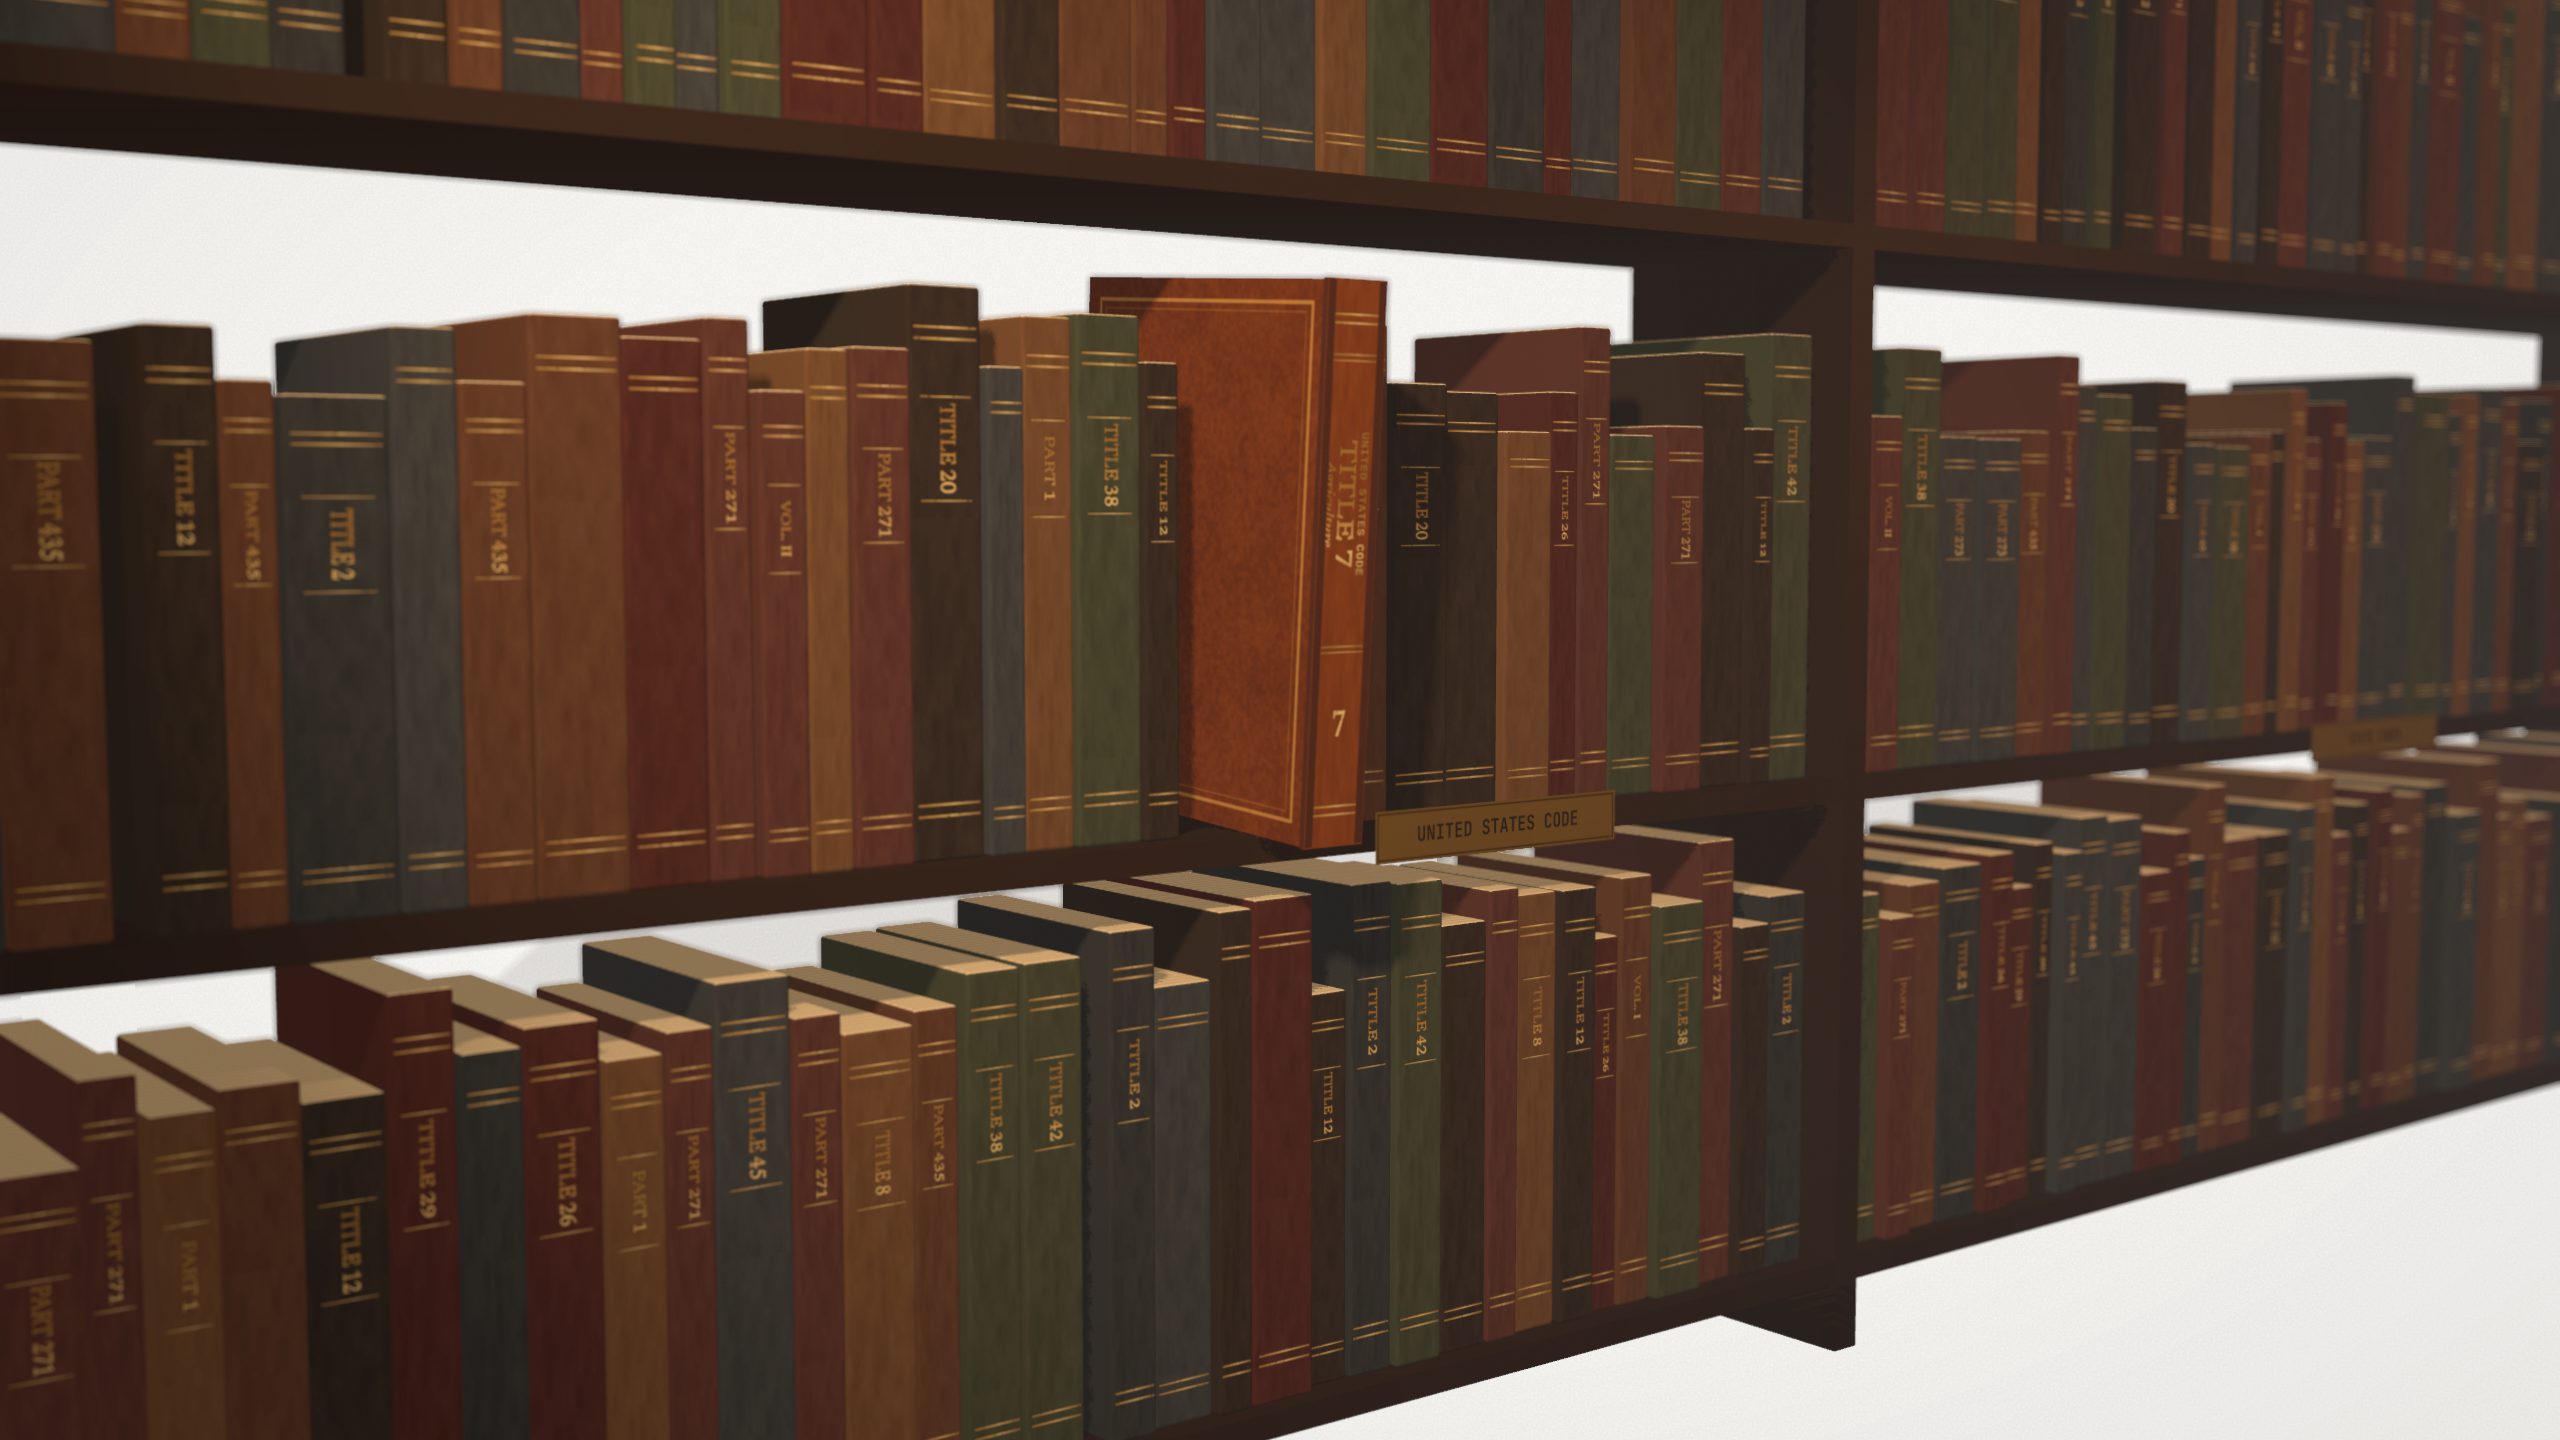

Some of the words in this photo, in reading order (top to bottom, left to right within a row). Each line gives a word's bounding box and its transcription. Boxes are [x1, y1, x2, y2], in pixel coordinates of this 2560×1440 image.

[939, 402, 958, 466] TITLE
[1104, 423, 1119, 481] TITLE
[1787, 425, 1799, 475] TITLE
[724, 431, 738, 484] PART
[1044, 436, 1056, 486] PART
[1360, 432, 1370, 481] UNITED
[1916, 433, 1928, 480] TITLE
[36, 460, 63, 521] PART
[174, 447, 196, 517] TITLE
[878, 453, 892, 502] PART
[939, 470, 958, 495] 20
[1159, 460, 1168, 513] TITLE
[1335, 440, 1358, 541] TITLE
[1416, 472, 1429, 519] TITLE
[1592, 470, 1600, 500] 271
[1786, 476, 1798, 497] 42
[489, 487, 508, 538] PART
[724, 489, 738, 523] 271
[1044, 492, 1056, 501] 1
[1104, 485, 1119, 508] 38
[1357, 488, 1368, 536] STATES
[1561, 475, 1569, 520] TITLE
[176, 522, 197, 548] 12
[243, 490, 261, 544] PART
[878, 506, 893, 538] 271
[1159, 516, 1168, 536] 12
[1416, 521, 1429, 541] 20
[1560, 523, 1569, 541] 26
[1681, 499, 1692, 534] PART
[328, 506, 356, 566] TITLE
[780, 545, 793, 558] II
[1680, 536, 1692, 560] 271
[330, 567, 357, 582] 2
[490, 538, 509, 575] 435
[1335, 550, 1353, 569] 7
[1355, 543, 1365, 576] CODE
[1332, 709, 1346, 738] 7
[1416, 820, 1473, 842] UNITED
[1481, 814, 1536, 836] STATES
[1544, 809, 1579, 829] CODE
[1713, 929, 1723, 971] PART
[1416, 979, 1428, 1032] TITLE
[1576, 976, 1585, 1024] TITLE
[1678, 983, 1690, 1026] TITLE
[1712, 974, 1723, 1003] 271
[1782, 972, 1793, 1014] TITLE
[1368, 987, 1378, 1041] TITLE
[1532, 986, 1543, 1034] TITLE
[1782, 1015, 1792, 1025] 2
[1368, 1044, 1378, 1056] 2
[1416, 1035, 1428, 1056] 42
[1532, 1037, 1542, 1047] 8
[1576, 1028, 1584, 1046] 12
[1602, 1012, 1610, 1054] TITLE
[1677, 1028, 1689, 1046] 38
[1128, 1037, 1142, 1095] TITLE
[1602, 1055, 1610, 1073] 26
[990, 1072, 1003, 1128] TITLE
[1050, 1060, 1064, 1117] TITLE
[1128, 1098, 1141, 1110] 2
[1324, 1071, 1333, 1115] TITLE
[748, 1091, 767, 1154] TITLE
[815, 1116, 828, 1164] PART
[933, 1104, 945, 1149] PART
[1050, 1119, 1064, 1142] 42
[1324, 1117, 1332, 1134] 12
[418, 1118, 436, 1190] TITLE
[688, 1134, 700, 1184] PART
[875, 1129, 892, 1183] TITLE
[990, 1132, 1004, 1153] 38
[558, 1135, 577, 1200] TITLE
[748, 1155, 768, 1181] 45
[815, 1168, 828, 1200] 271
[934, 1152, 946, 1183] 435
[420, 1192, 438, 1219] 29
[632, 1169, 647, 1219] PART
[688, 1187, 701, 1221] 271
[875, 1184, 892, 1197] 8
[105, 1201, 124, 1262] PART
[558, 1202, 578, 1228] 26
[632, 1223, 648, 1234] 1
[340, 1204, 362, 1269] TITLE
[341, 1270, 363, 1296] 12
